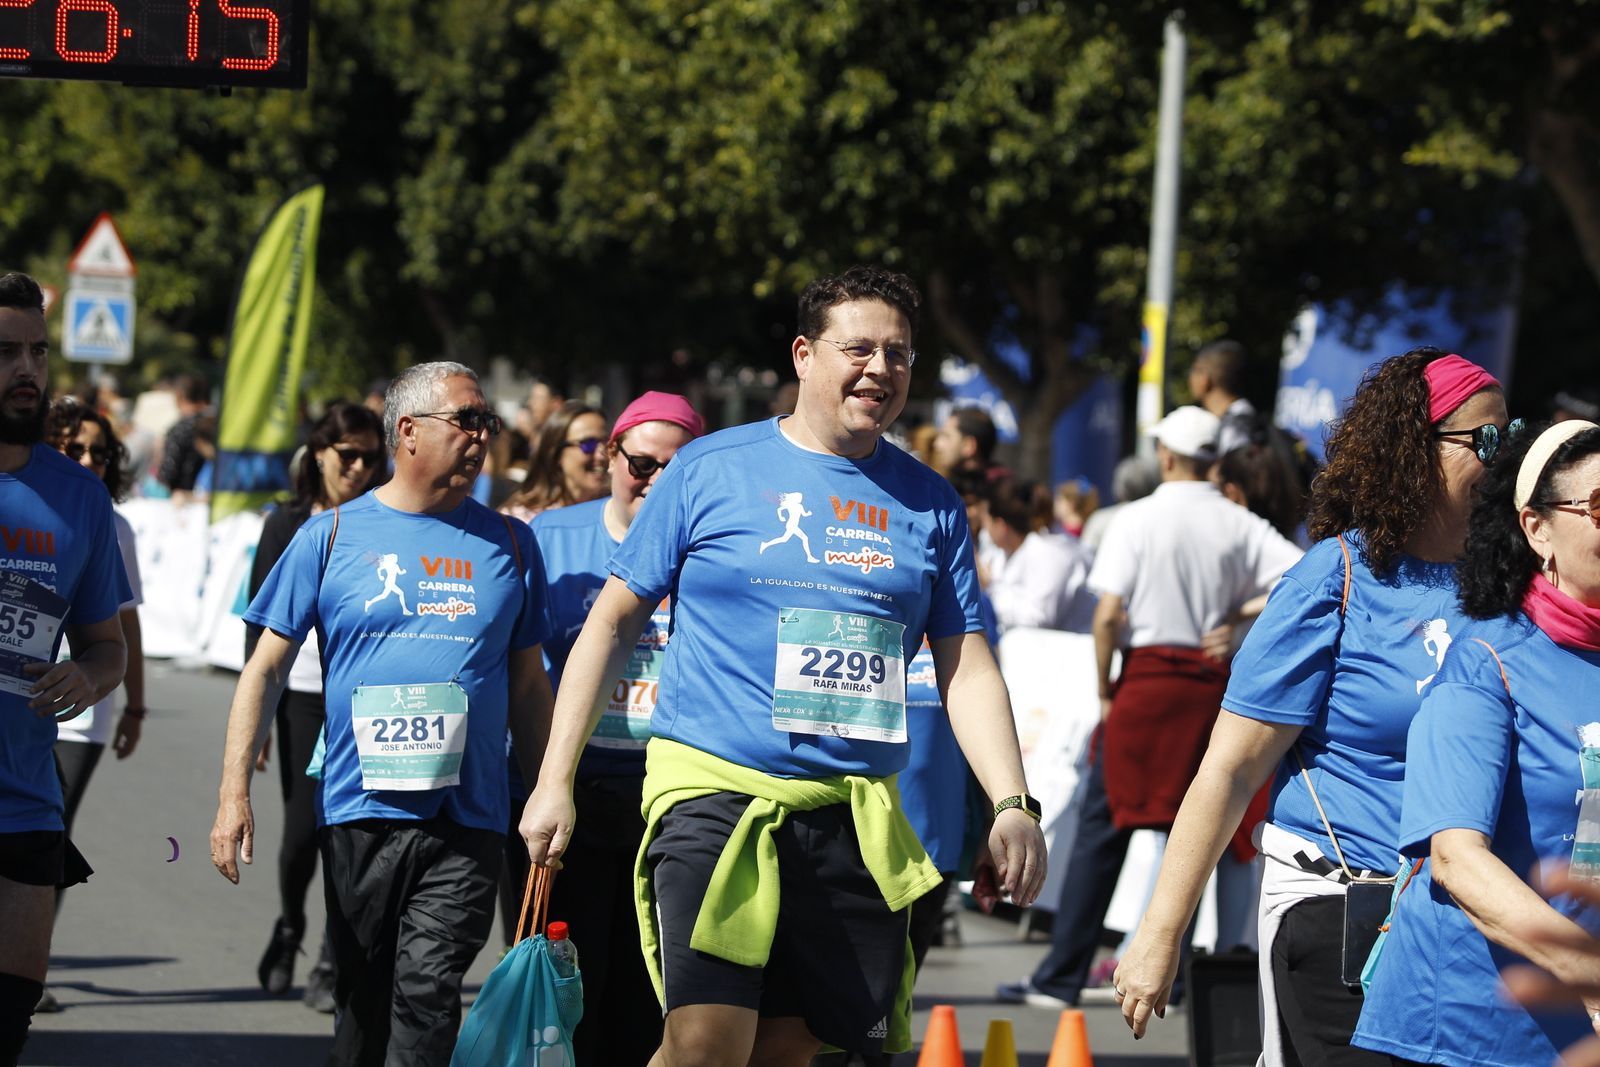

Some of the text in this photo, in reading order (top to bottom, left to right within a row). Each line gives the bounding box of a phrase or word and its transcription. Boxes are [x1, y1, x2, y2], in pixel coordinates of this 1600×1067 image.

[829, 496, 889, 532] VIII
[0, 526, 56, 557] VIII
[825, 526, 892, 546] CARRERA
[0, 558, 57, 574] CARRERA
[420, 555, 472, 581] VIII
[9, 573, 29, 586] VIII
[418, 581, 475, 594] CARRERA
[765, 578, 814, 589] IGUALDAD
[817, 583, 828, 591] ES
[830, 585, 870, 597] NUESTRA
[870, 591, 893, 602] META
[0, 604, 39, 640] 55
[848, 616, 867, 627] VIII
[420, 633, 454, 641] NUESTRA
[799, 647, 886, 684] 2299
[407, 687, 426, 695] VIII
[813, 679, 838, 690] RAFA
[841, 682, 873, 693] MIRAS
[371, 715, 445, 743] 2281
[381, 742, 442, 751] JOSE ANTONIO
